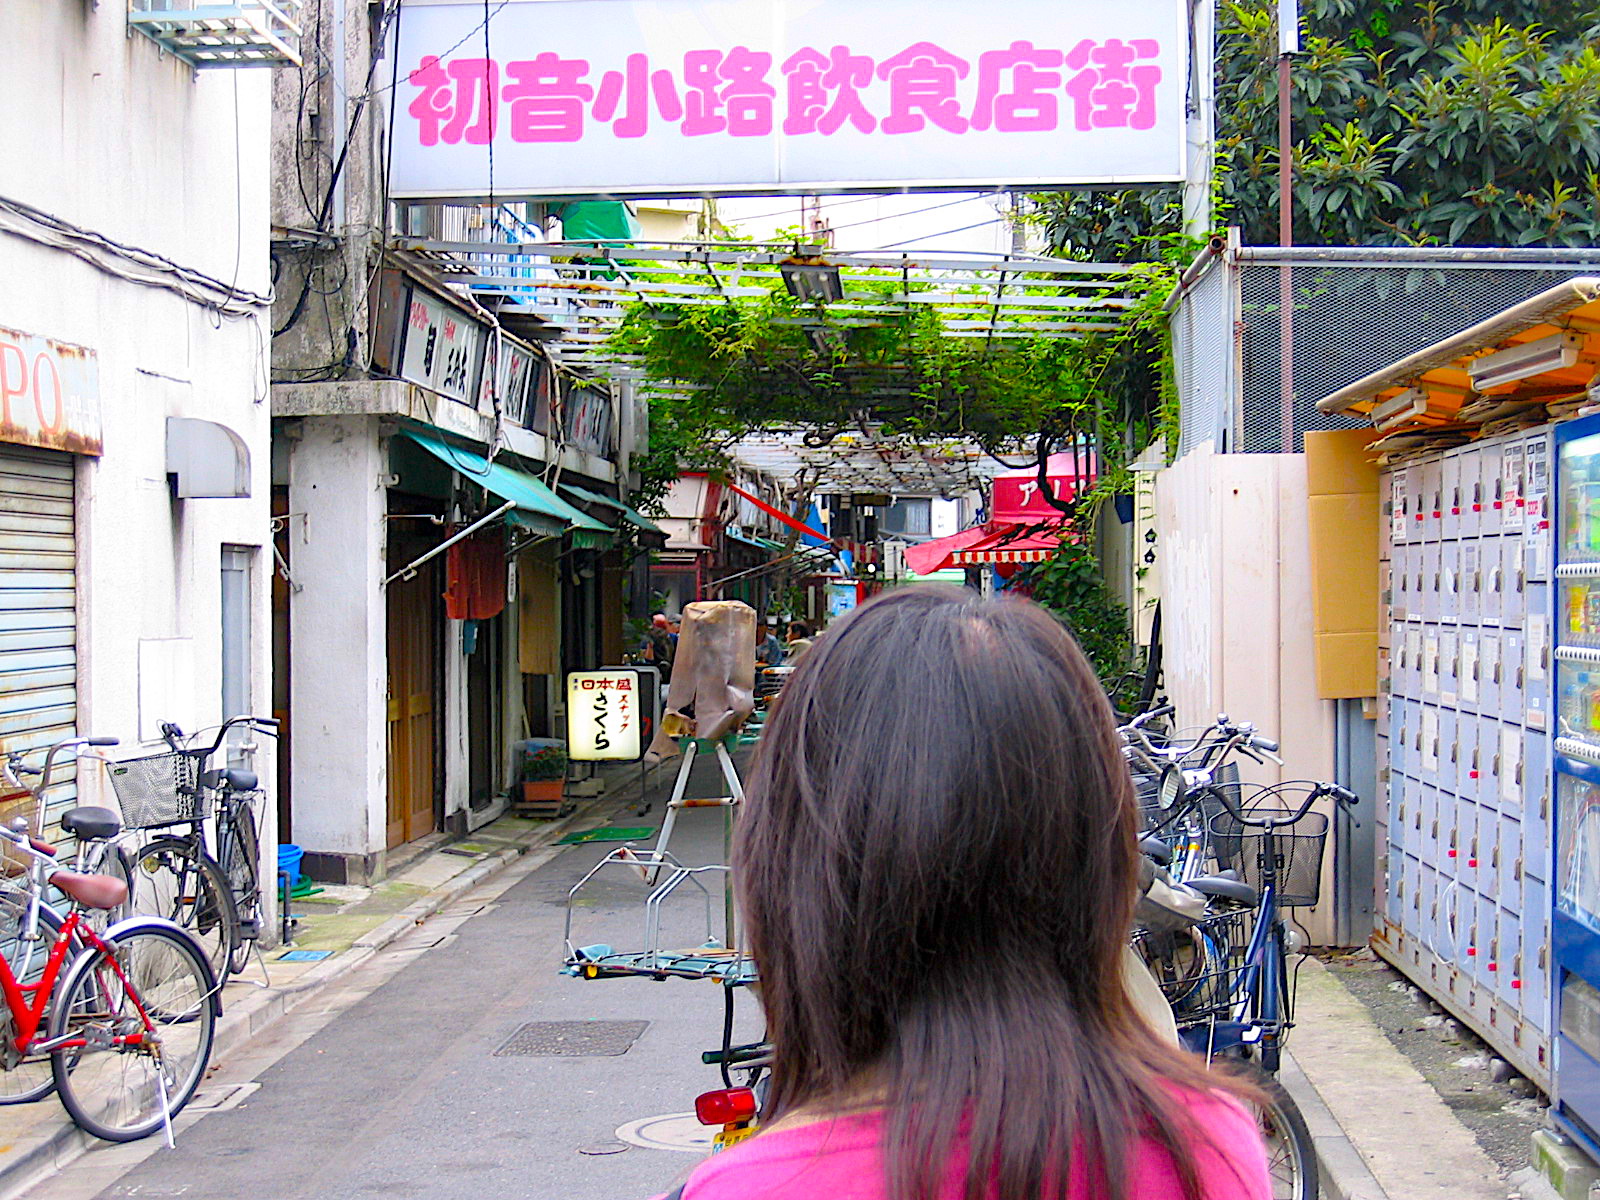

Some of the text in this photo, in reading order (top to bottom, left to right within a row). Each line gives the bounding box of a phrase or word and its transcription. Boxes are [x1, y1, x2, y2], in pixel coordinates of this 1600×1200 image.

[408, 38, 1161, 147] 初音小路飲食店街
[580, 676, 633, 692] 日本盛
[592, 691, 610, 751] さくら
[617, 693, 631, 734] スナック
